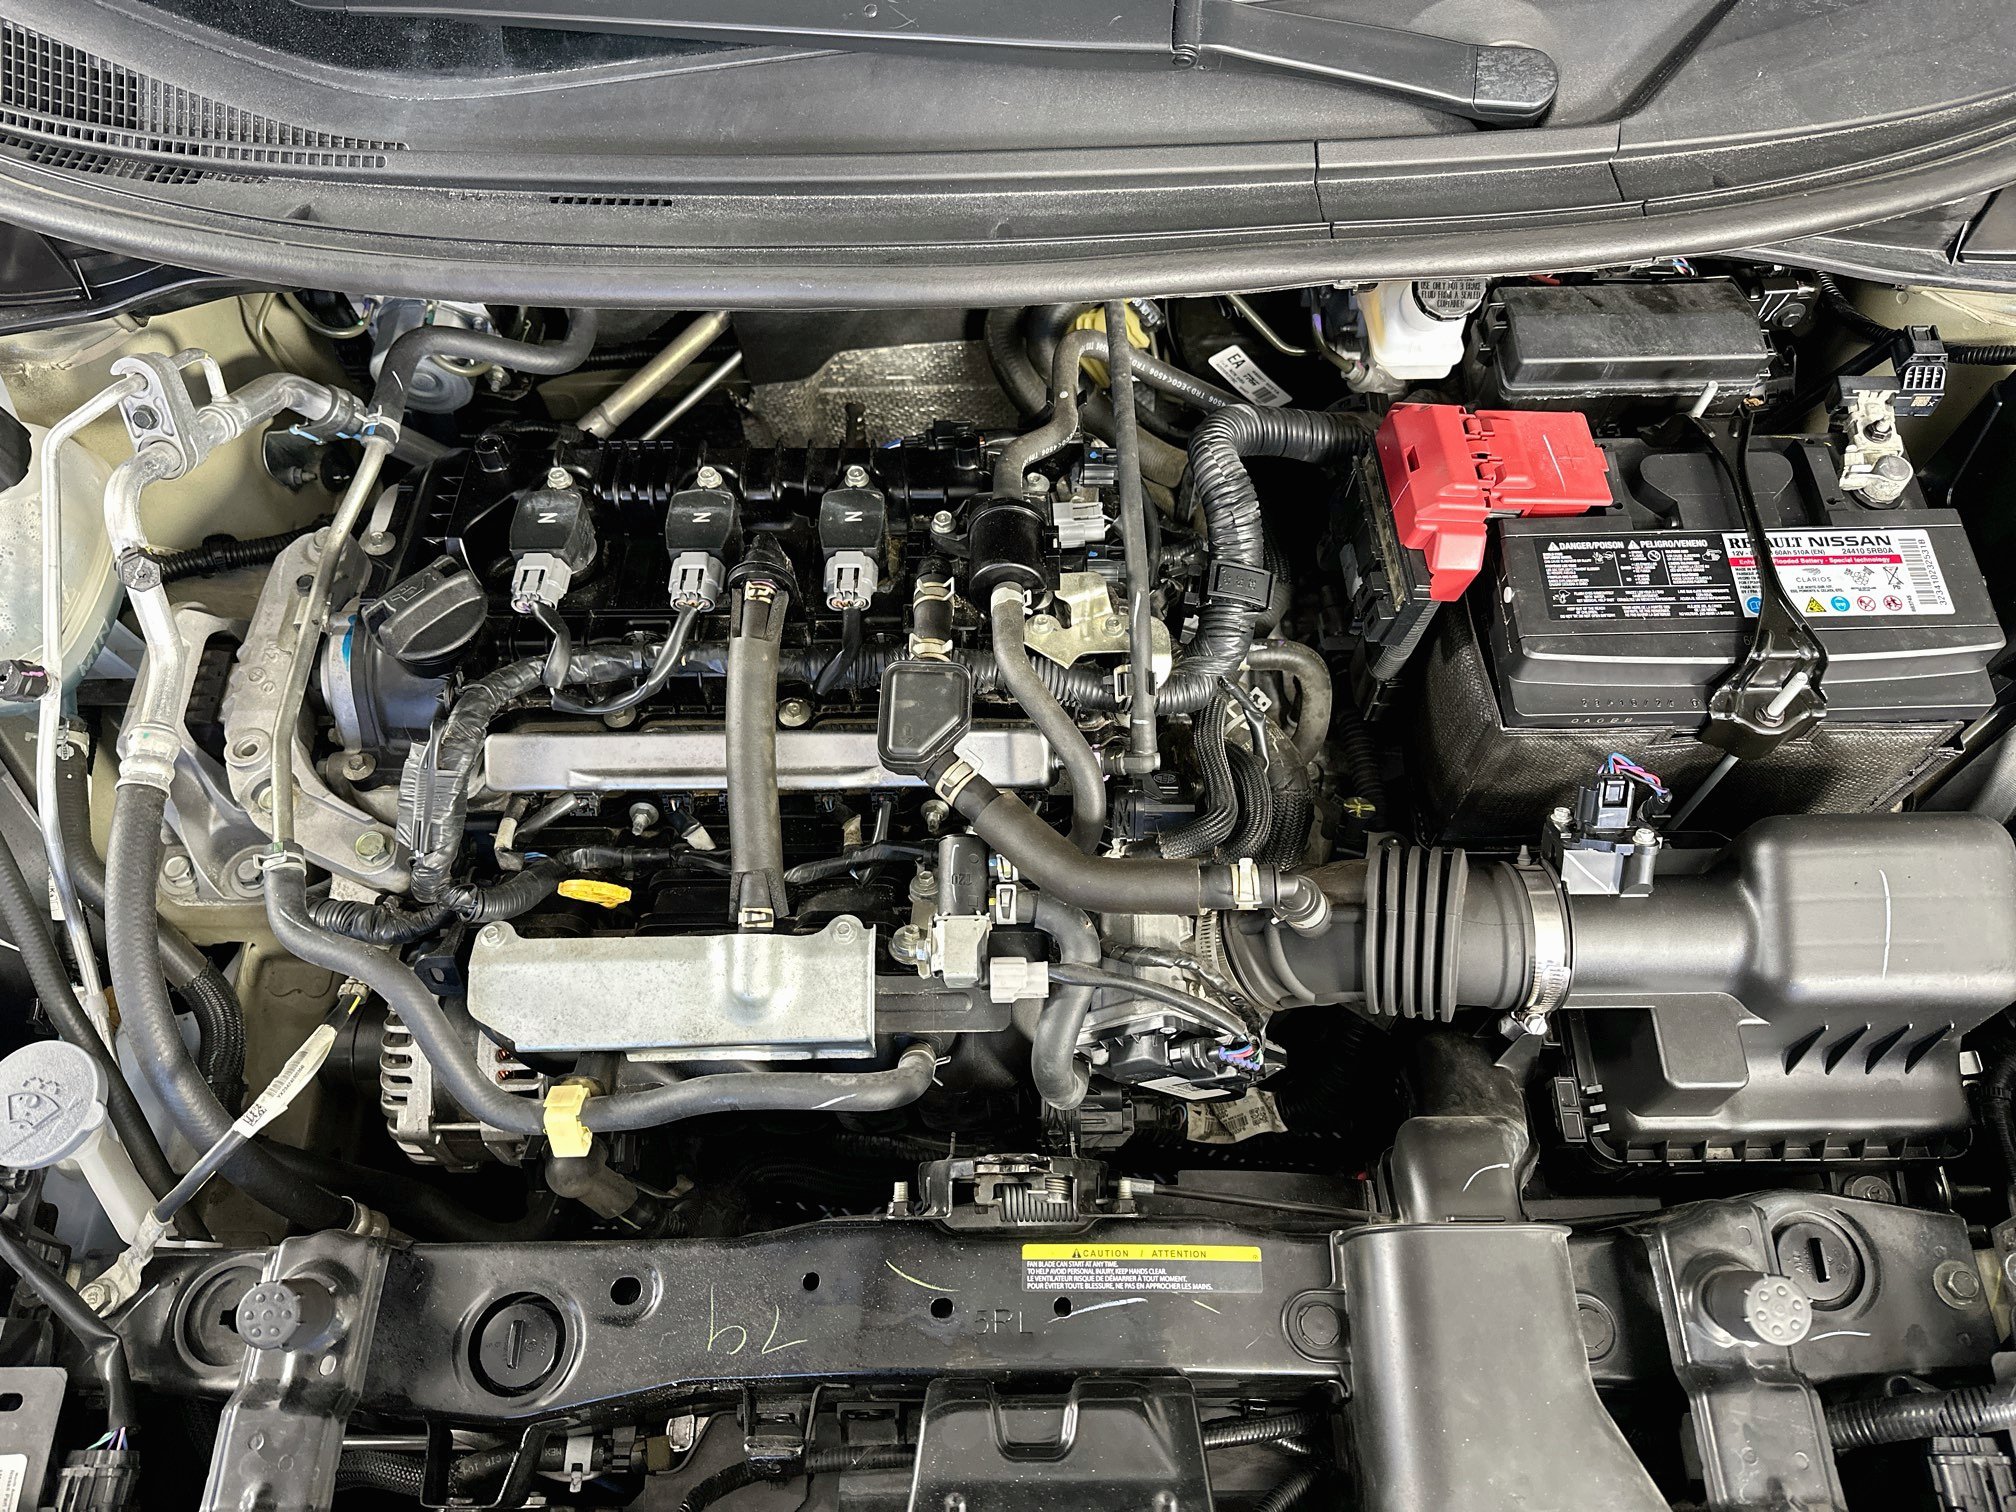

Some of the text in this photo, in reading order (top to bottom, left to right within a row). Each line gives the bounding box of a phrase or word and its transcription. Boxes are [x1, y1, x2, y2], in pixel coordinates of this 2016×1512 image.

[1228, 353, 1246, 369] EA
[1559, 541, 1624, 550] DANGER/POISON
[1640, 540, 1708, 548] PELIGRO/VENENO
[1808, 536, 1892, 546] NISSAN
[1083, 1249, 1129, 1258] CAUTION
[1152, 1250, 1207, 1258] ATTENTION
[1104, 1274, 1137, 1282] DÉMARRER
[974, 1309, 1033, 1336] 5RL
[544, 1448, 562, 1456] MEX
